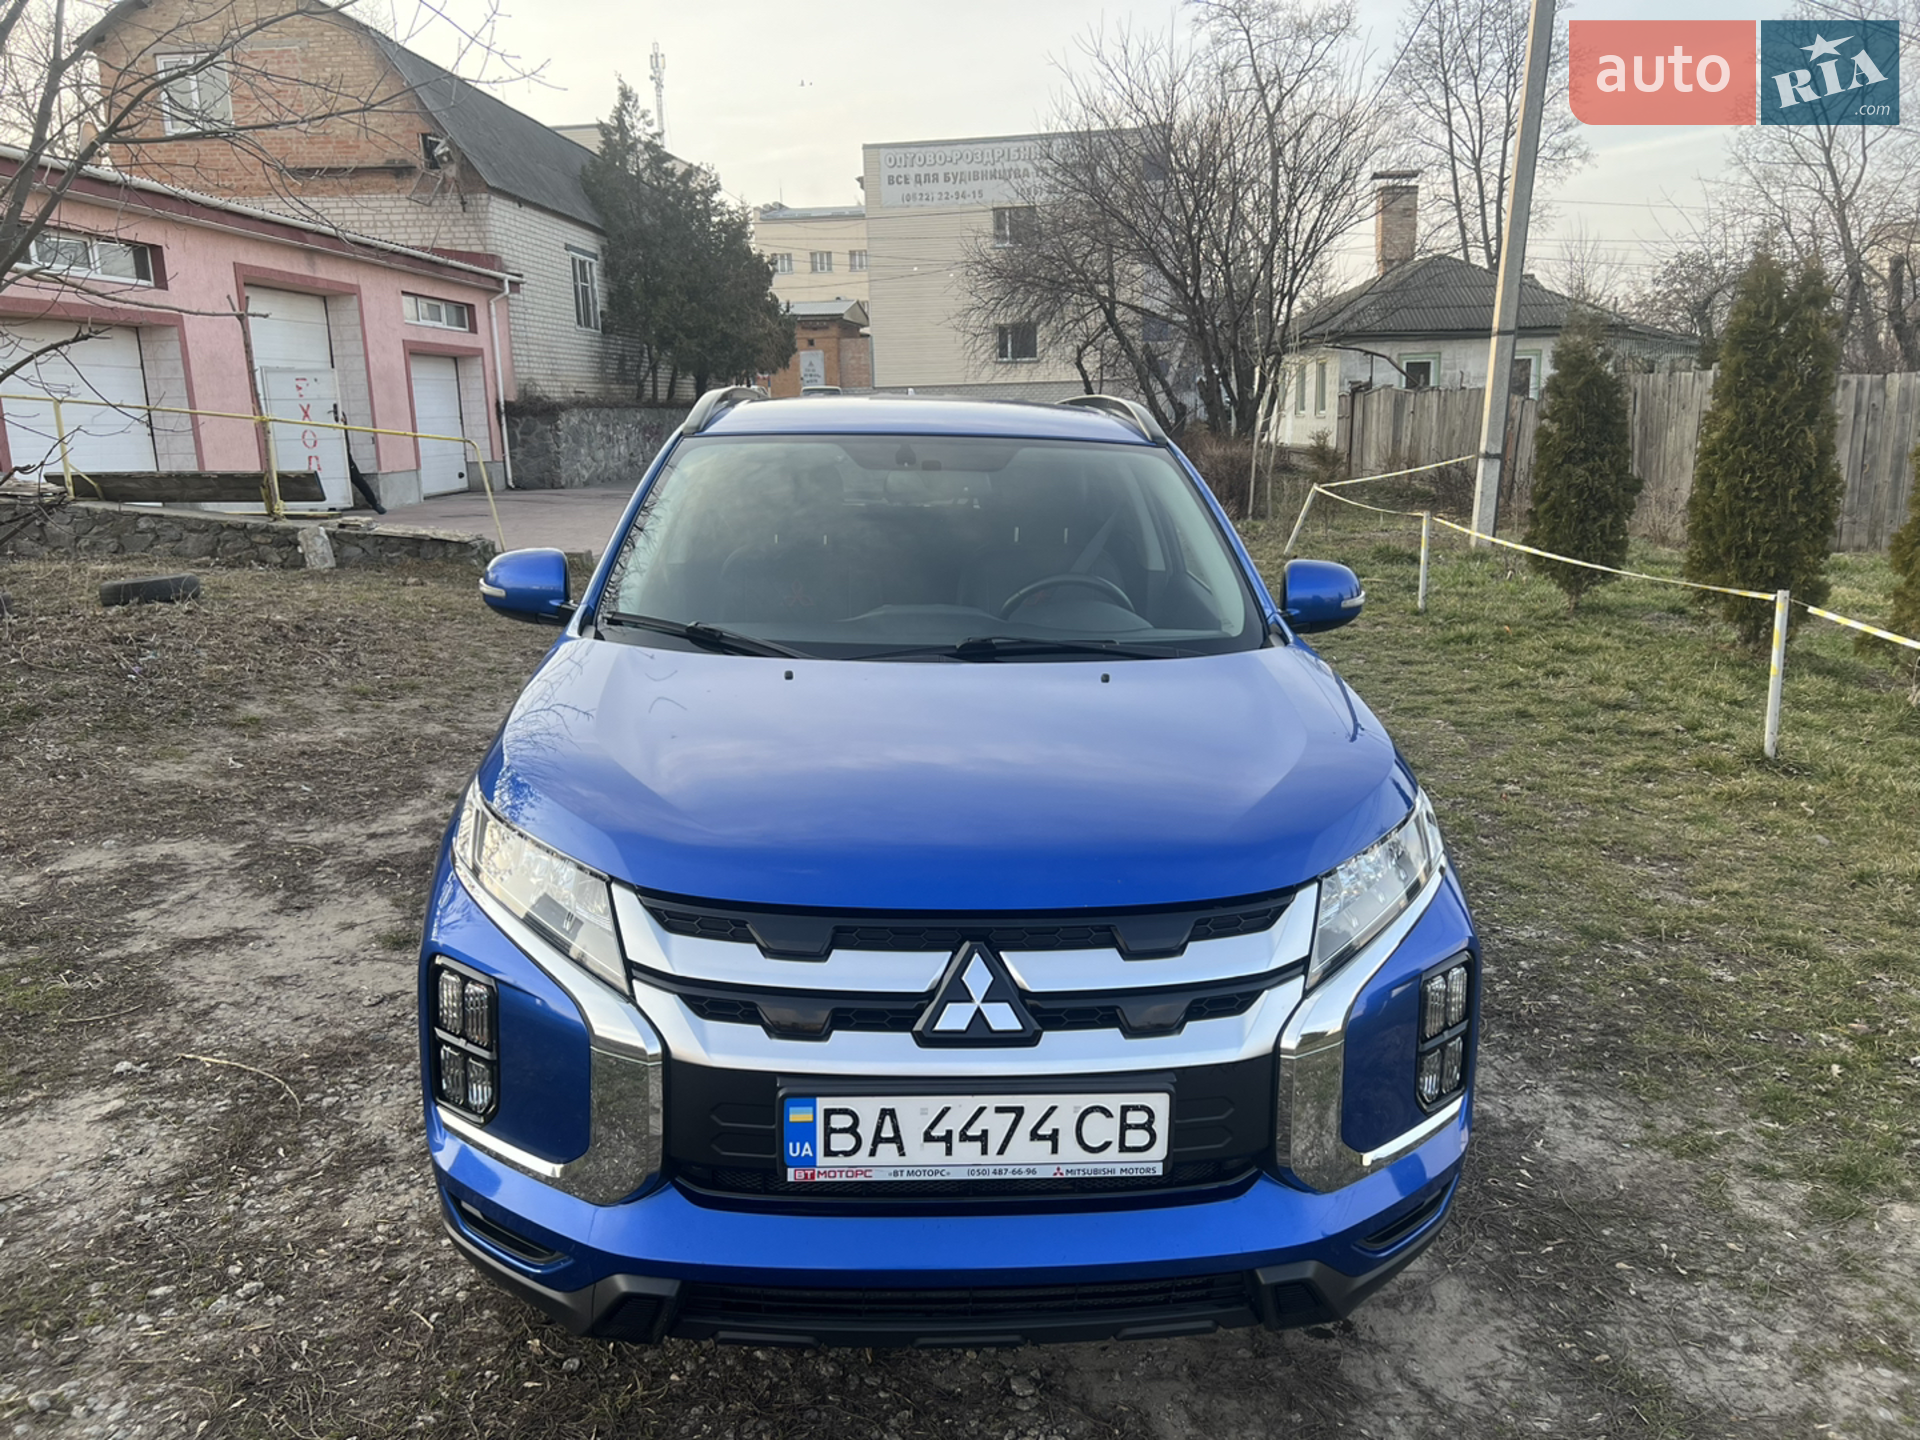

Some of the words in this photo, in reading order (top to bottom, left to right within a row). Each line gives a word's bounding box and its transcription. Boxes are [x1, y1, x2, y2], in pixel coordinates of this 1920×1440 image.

[887, 174, 911, 186] ВСЕ
[914, 171, 940, 187] ДЛЯ
[822, 1106, 906, 1158] BA
[922, 1104, 1060, 1157] 4474
[1074, 1103, 1158, 1154] CB
[788, 1142, 814, 1158] UA
[967, 1168, 990, 1177] (050)
[991, 1167, 1038, 1176] 487-66-96
[1065, 1167, 1116, 1177] MITSUBISHI
[1119, 1166, 1157, 1176] MOTORS
